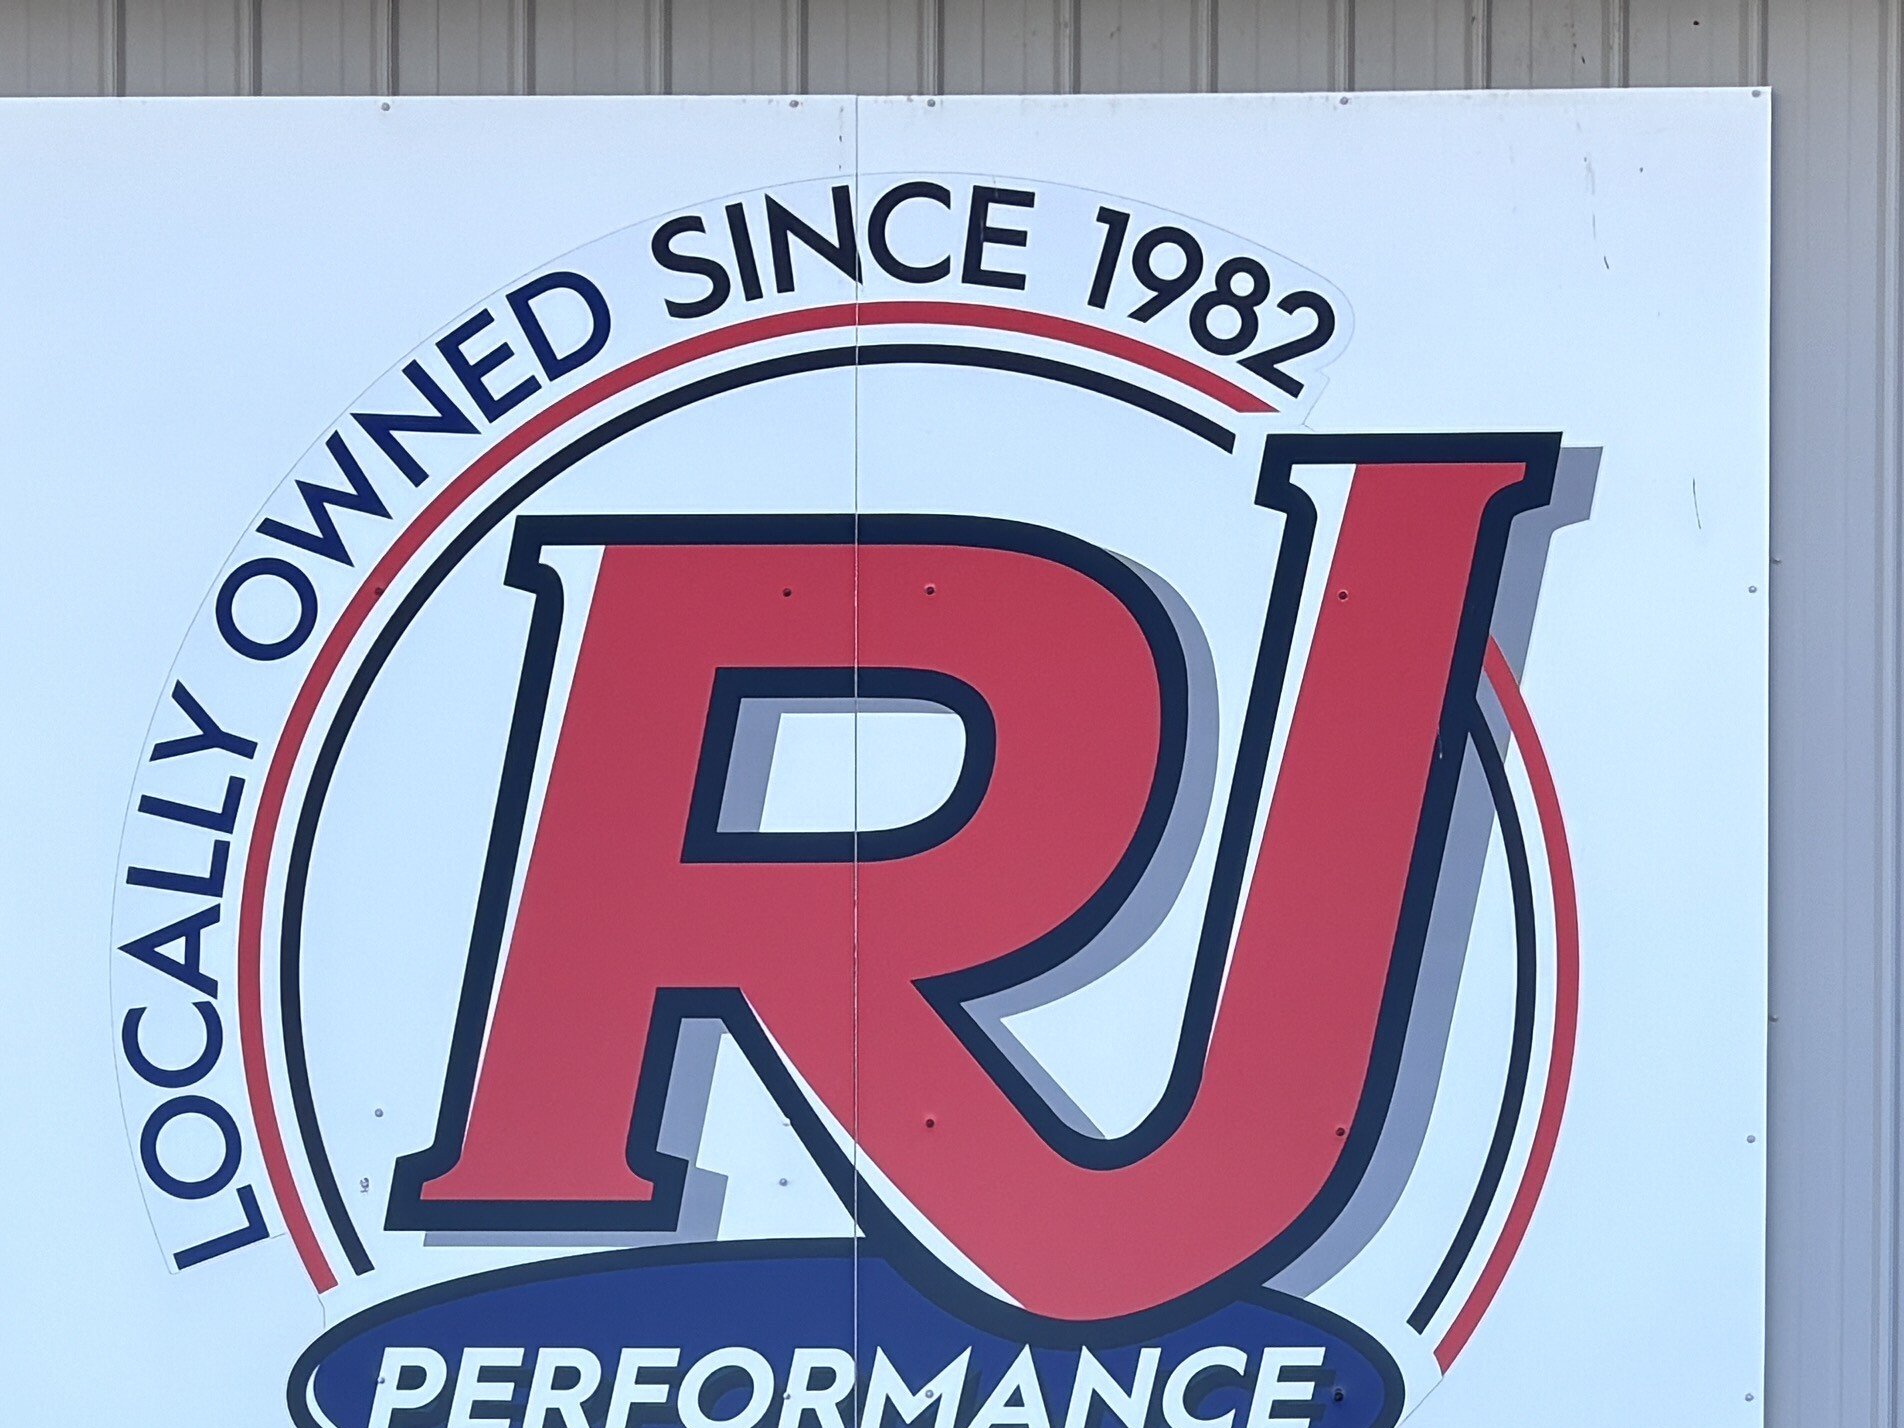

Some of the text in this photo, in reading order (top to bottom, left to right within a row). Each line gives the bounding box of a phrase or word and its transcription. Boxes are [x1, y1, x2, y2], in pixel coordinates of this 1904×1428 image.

[118, 182, 1335, 1270] LOCALLY OWNED SINCE 1982
[384, 431, 1563, 1345] RJ
